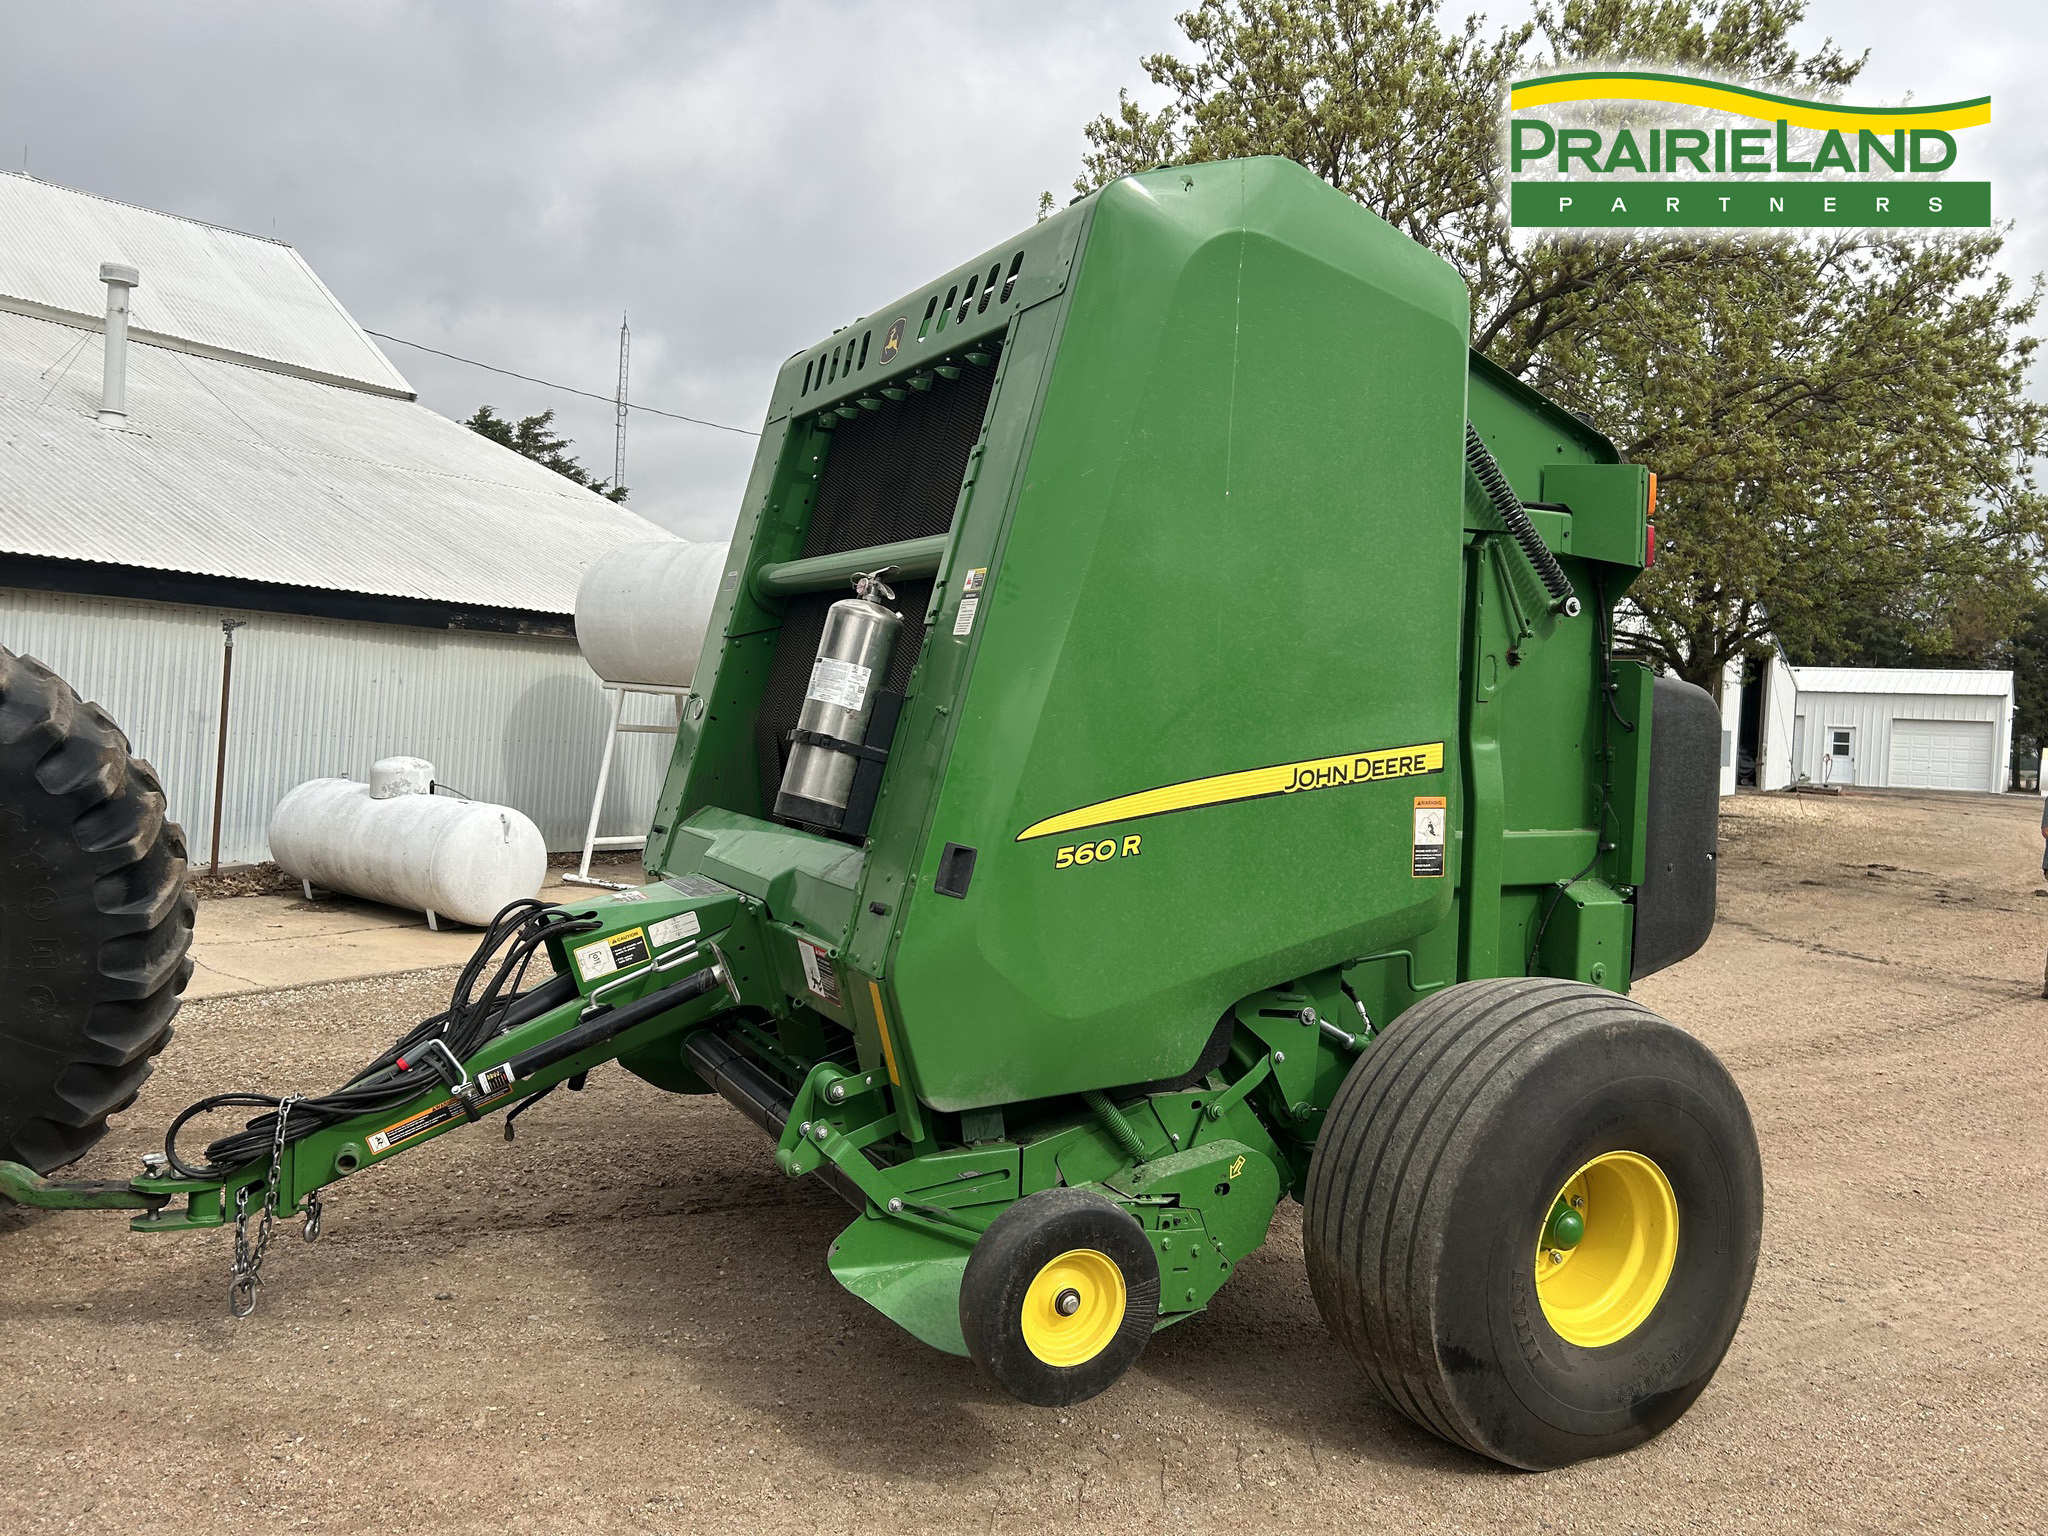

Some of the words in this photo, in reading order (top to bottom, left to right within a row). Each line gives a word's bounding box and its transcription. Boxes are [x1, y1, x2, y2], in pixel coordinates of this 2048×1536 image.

[1284, 763, 1349, 792] JOHN
[1353, 753, 1427, 779] DEERE
[1054, 837, 1117, 870] 560
[1120, 833, 1142, 858] R
[616, 931, 639, 943] CAUTION
[1511, 1269, 1545, 1373] TITAN
